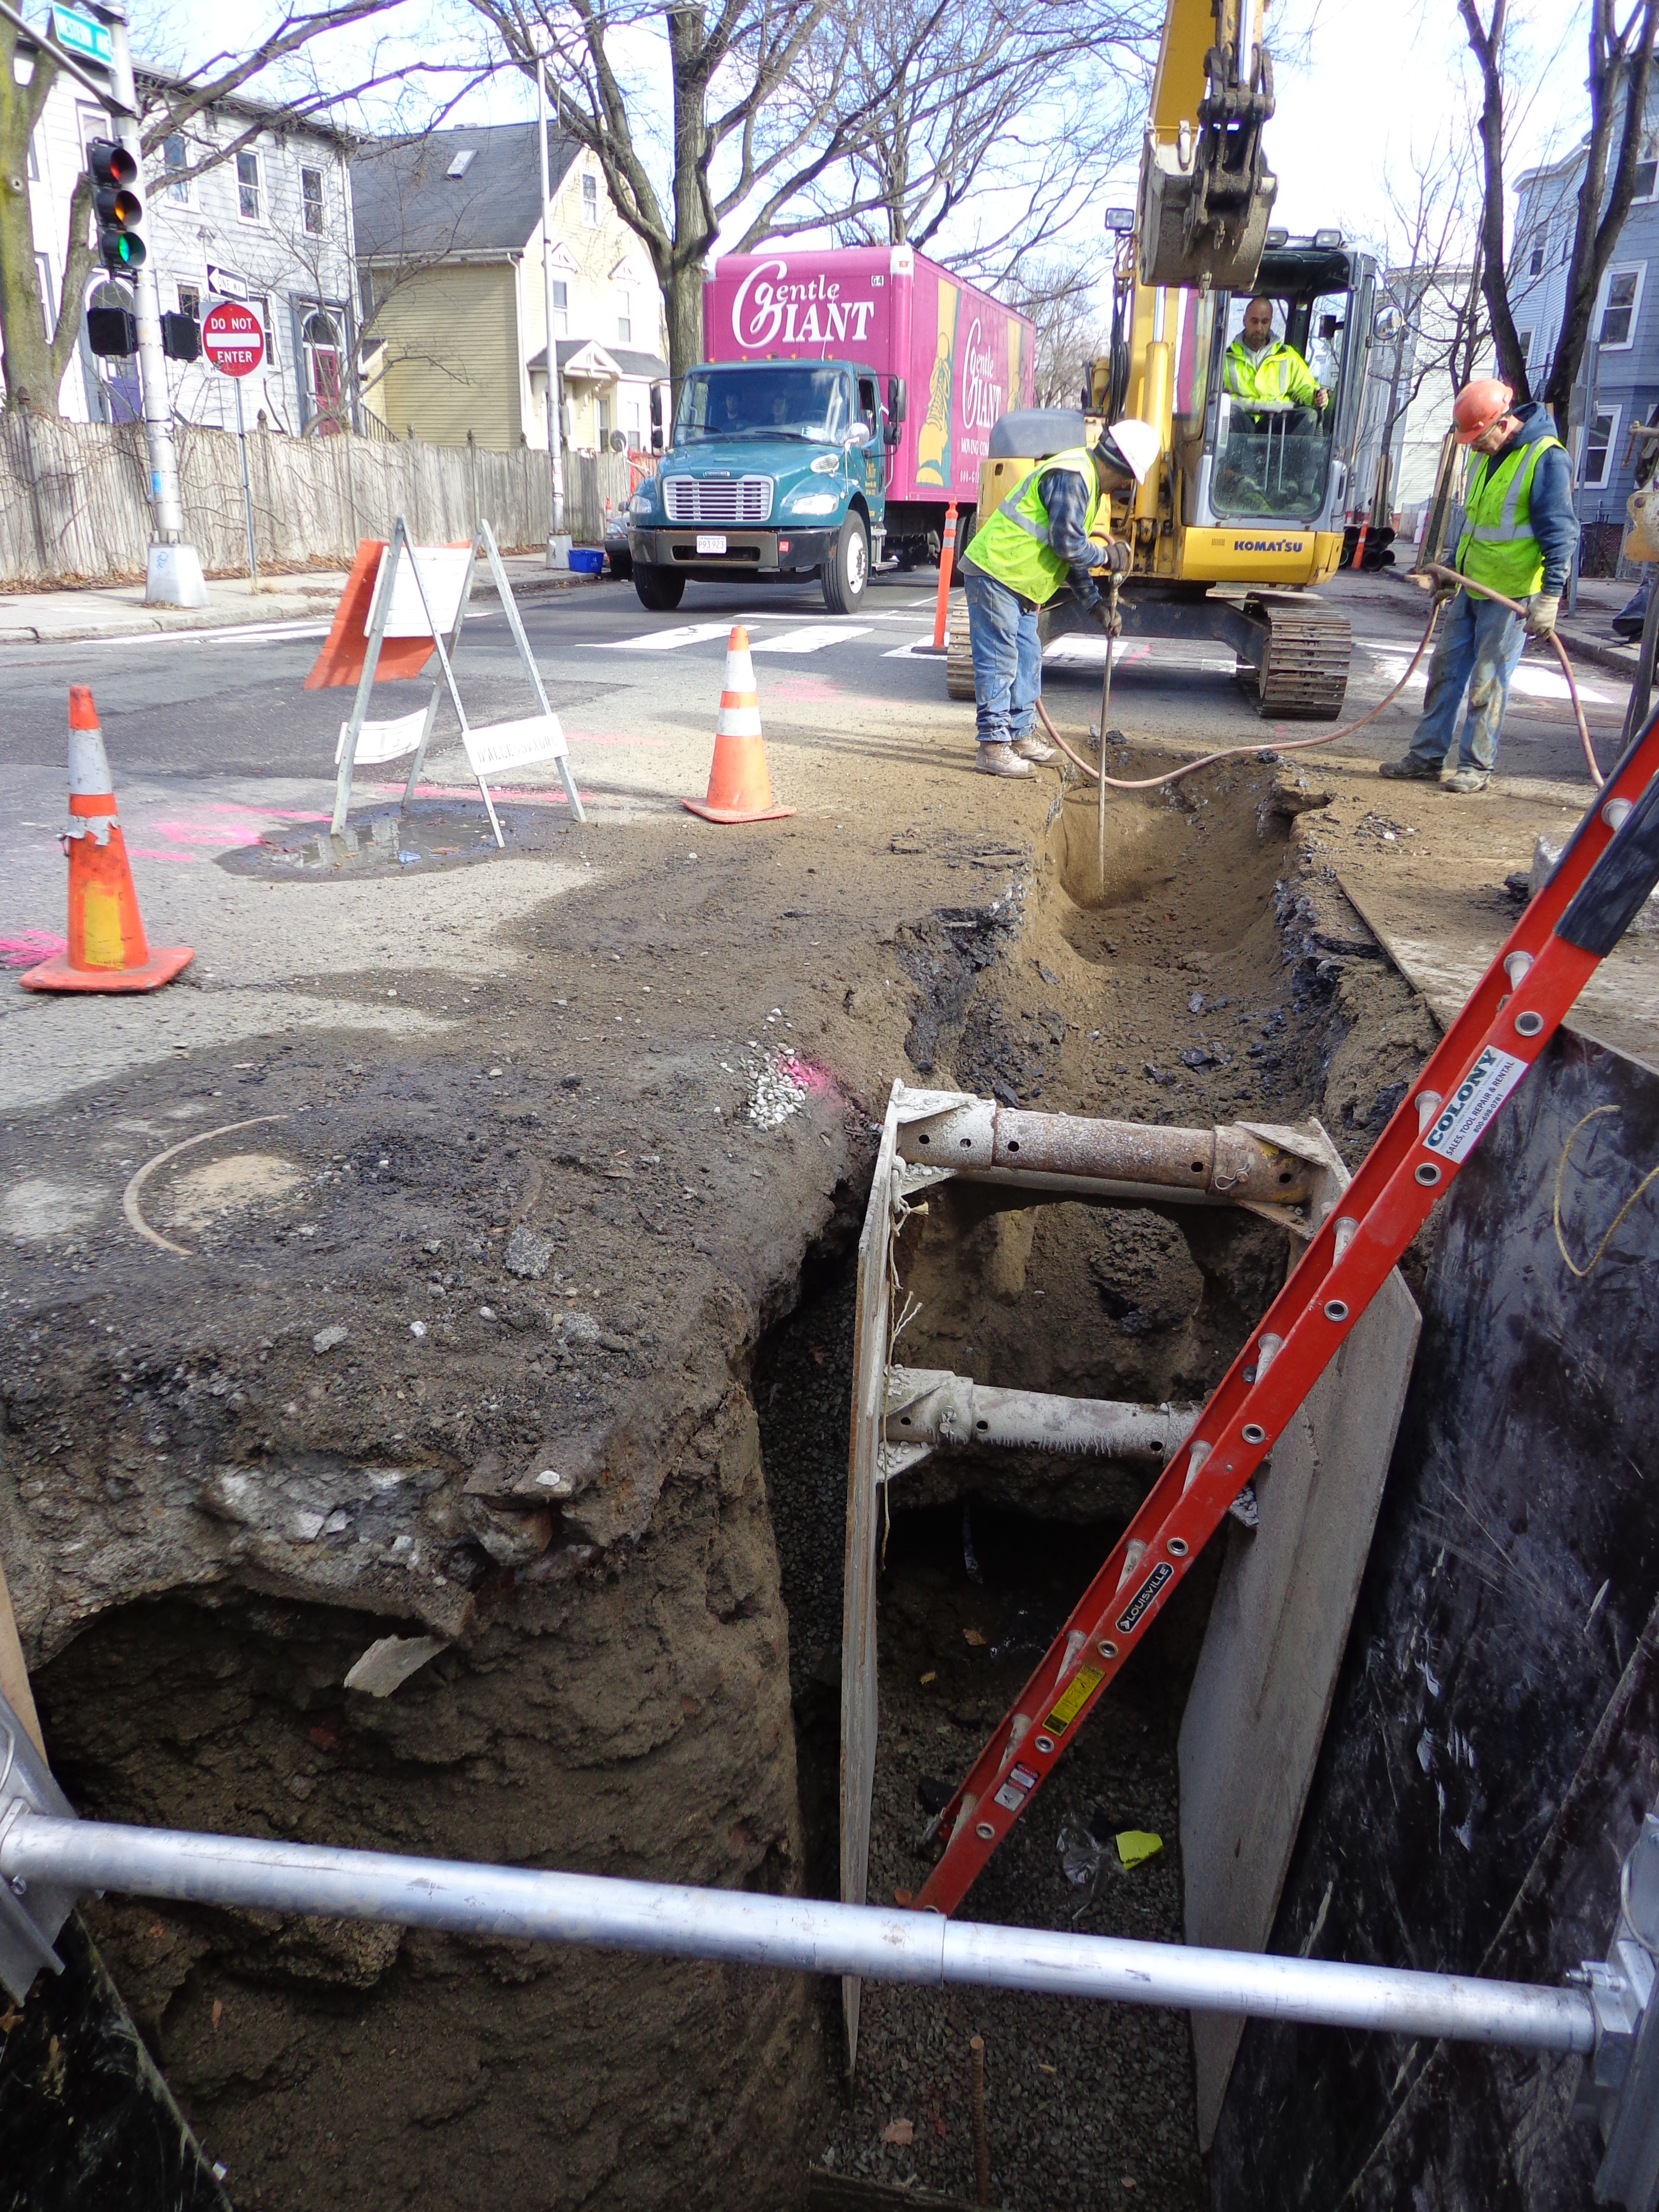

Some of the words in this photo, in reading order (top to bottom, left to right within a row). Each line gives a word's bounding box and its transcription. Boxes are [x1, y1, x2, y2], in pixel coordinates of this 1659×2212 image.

[217, 276, 229, 289] ONE
[233, 284, 244, 294] WAY
[732, 260, 840, 343] Gentle
[211, 318, 226, 329] DO
[231, 318, 252, 329] NOT
[217, 351, 253, 362] ENTER
[961, 437, 979, 455] MOVING
[1234, 539, 1303, 553] KOMATSU
[1428, 1049, 1497, 1147] COLONY
[1446, 1134, 1466, 1155] SALES,
[1460, 1116, 1476, 1135] TOOL
[1472, 1093, 1492, 1117] REPAIR
[1492, 1061, 1515, 1087] RENTAL
[1473, 1094, 1504, 1133] 800-698-0781
[1126, 1567, 1169, 1622] LOUISVILLE
